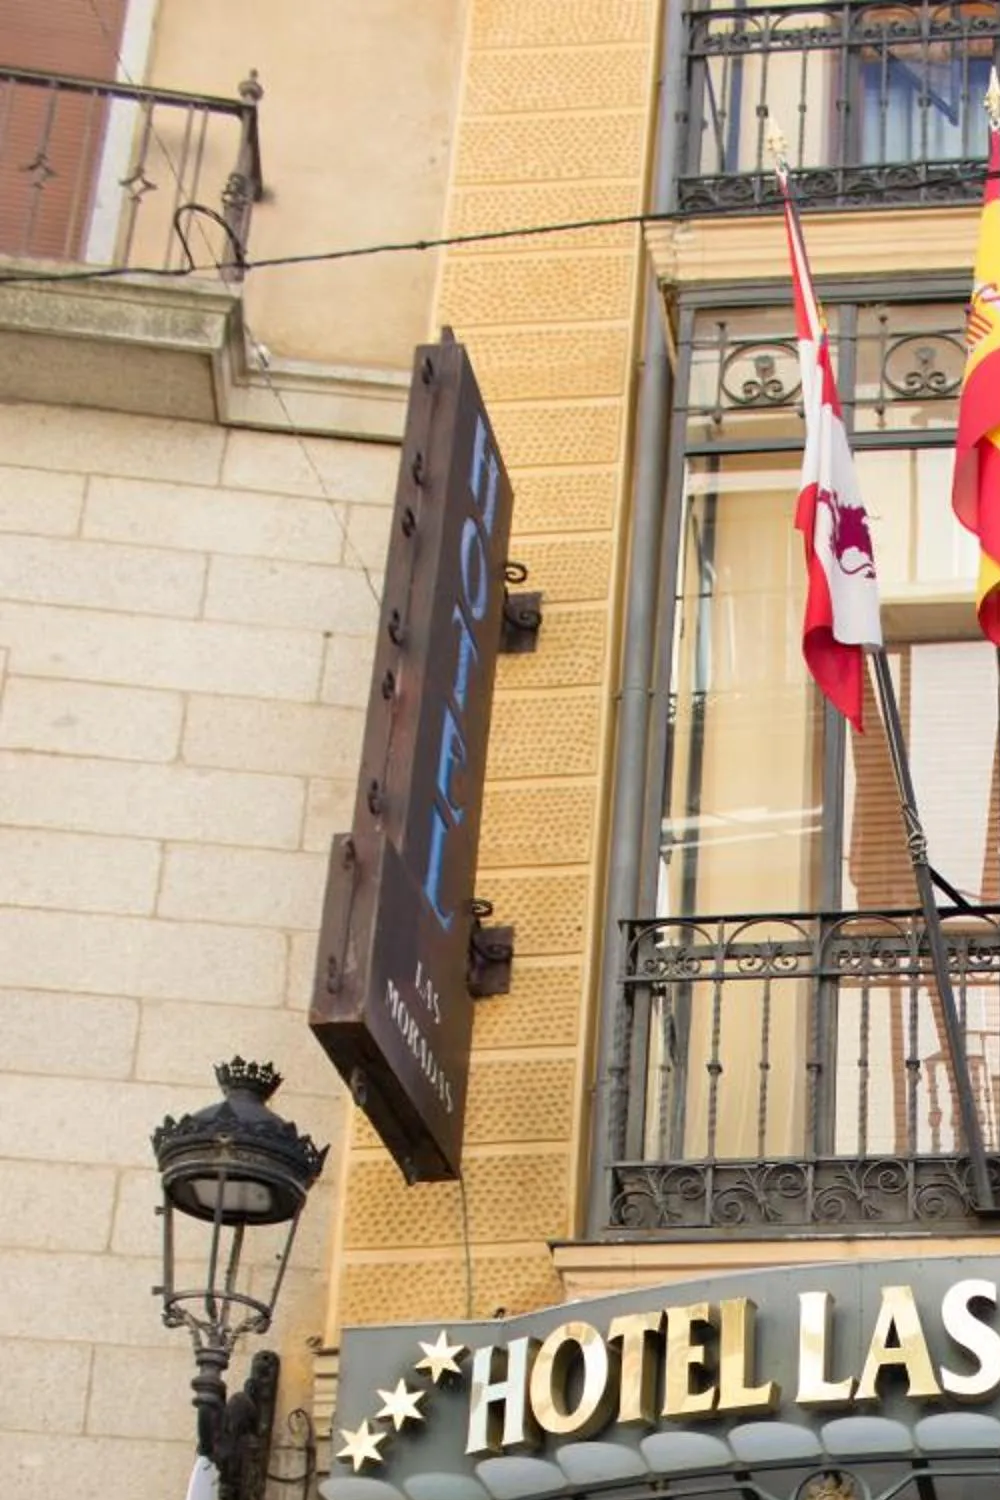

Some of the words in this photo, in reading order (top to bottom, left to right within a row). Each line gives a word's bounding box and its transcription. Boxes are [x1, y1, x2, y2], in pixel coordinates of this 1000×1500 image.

[425, 415, 500, 931] HOTEL
[386, 978, 454, 1114] MORADAS
[414, 960, 442, 1025] LAS
[465, 1297, 781, 1455] HOTEL
